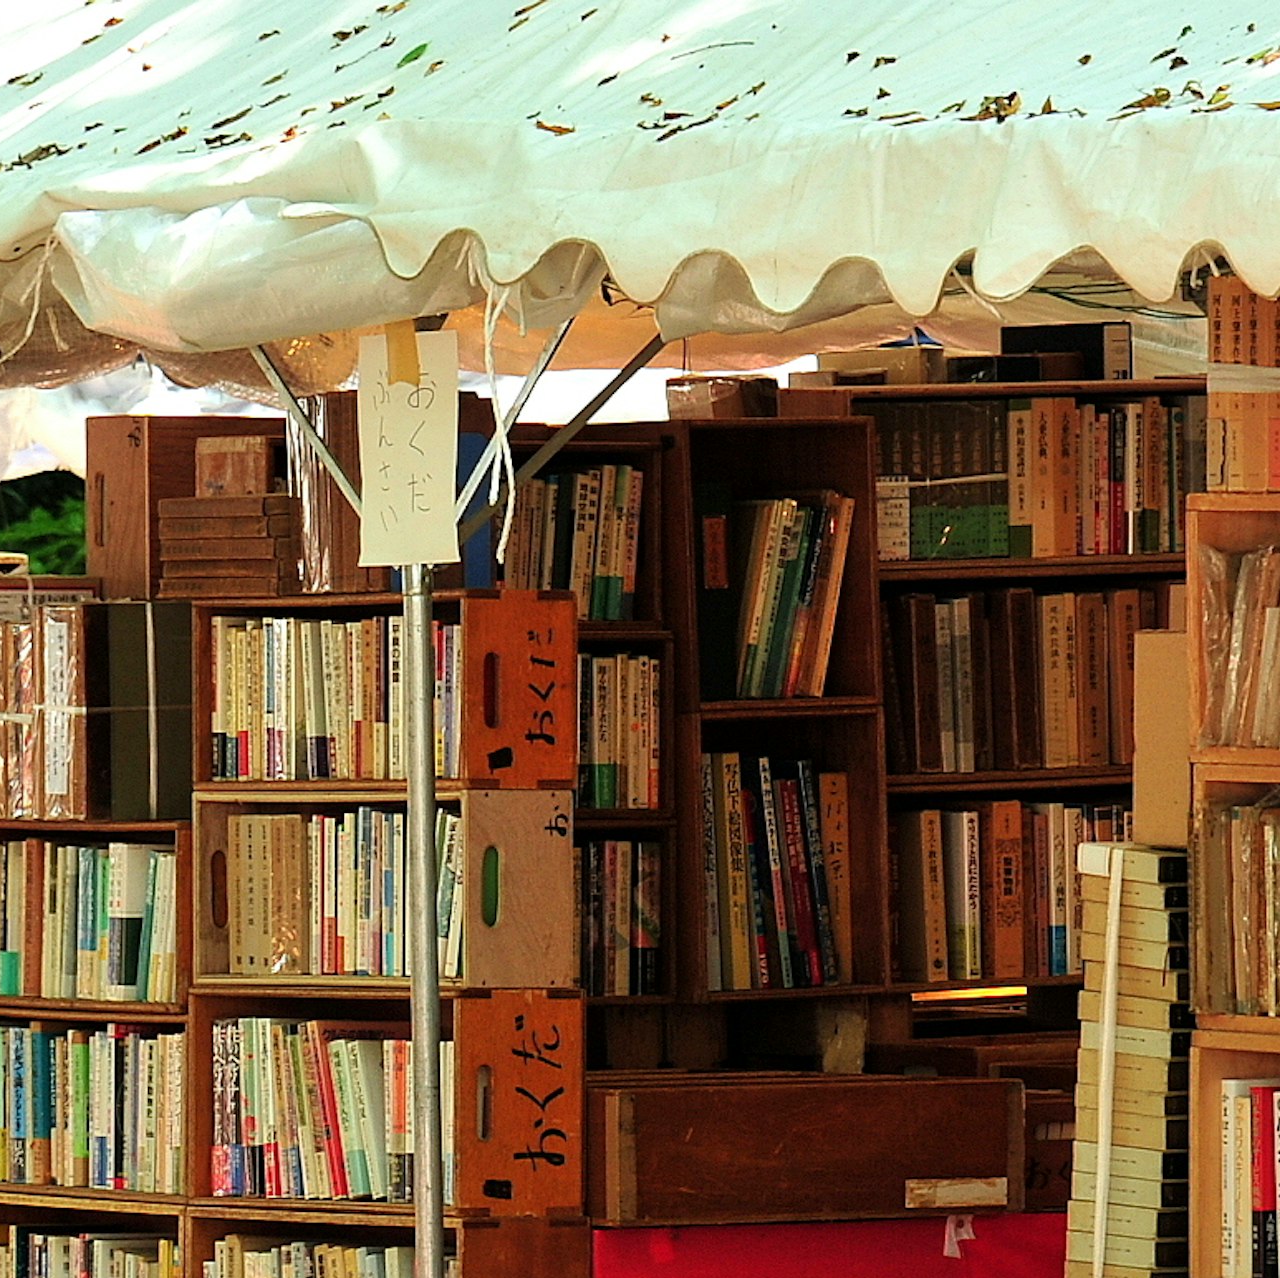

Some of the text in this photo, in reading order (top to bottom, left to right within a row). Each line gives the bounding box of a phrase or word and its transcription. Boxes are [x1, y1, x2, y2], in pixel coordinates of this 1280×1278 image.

[524, 628, 557, 746] おくだ
[511, 1013, 568, 1173] おくだ
